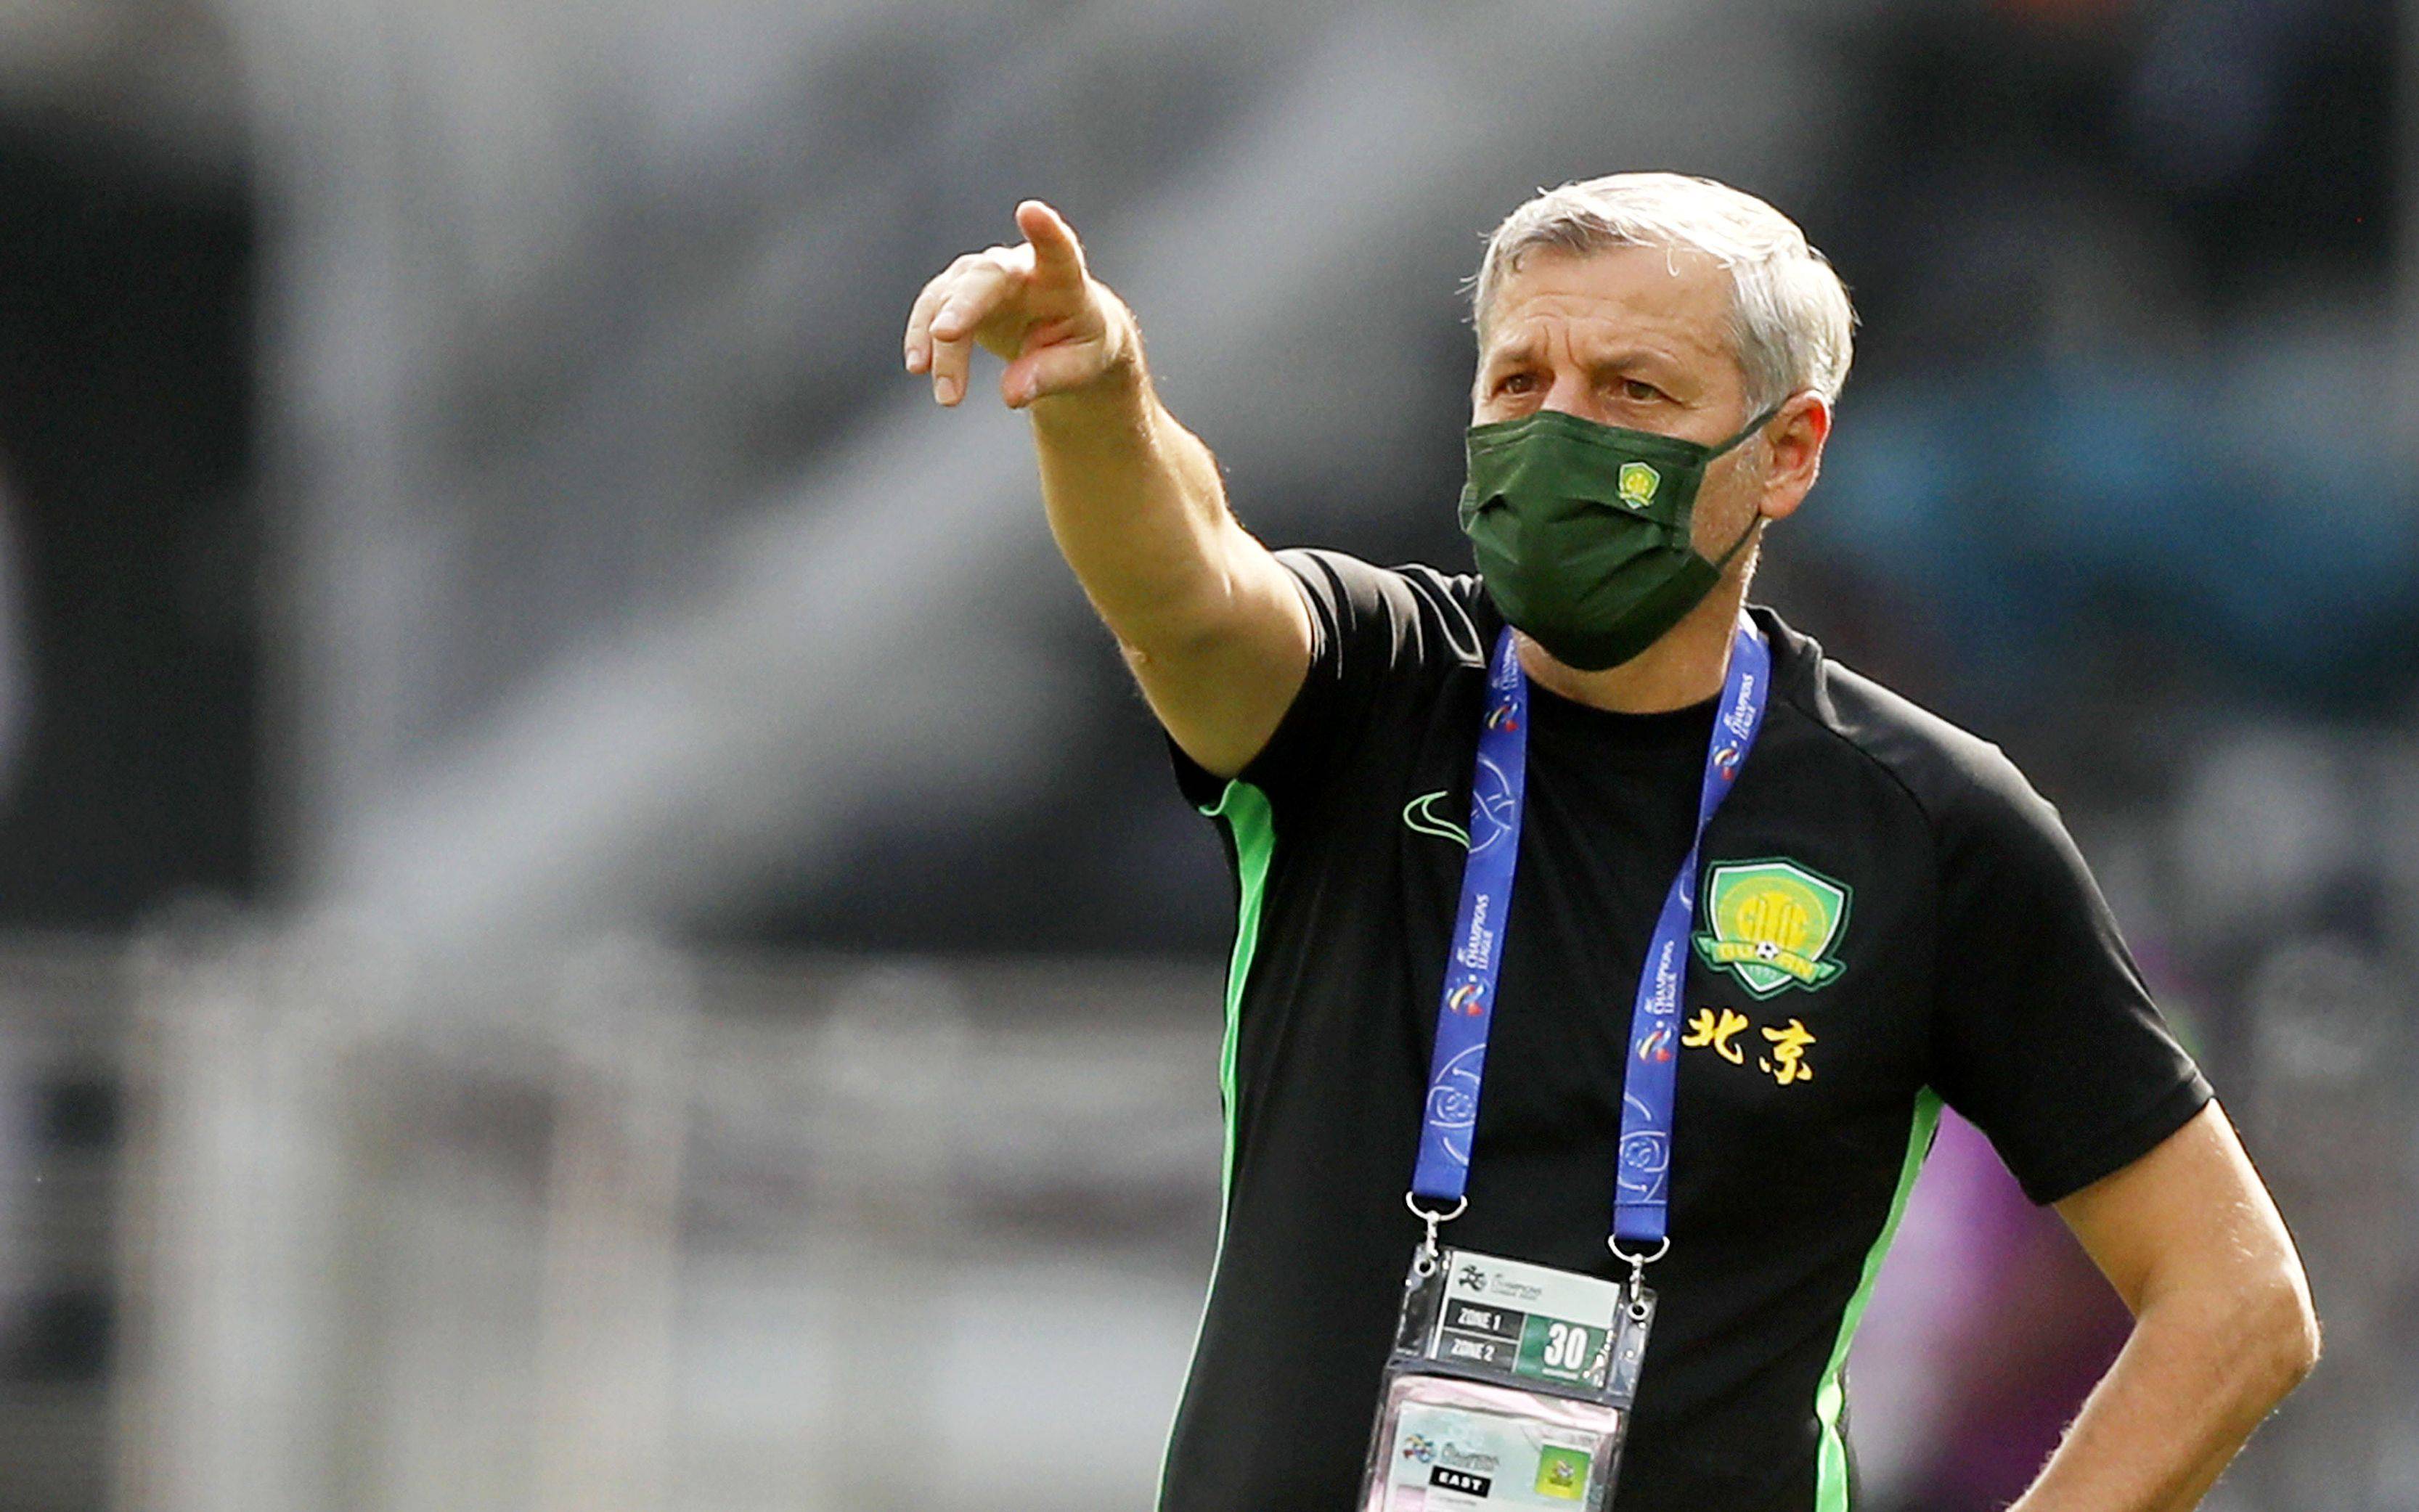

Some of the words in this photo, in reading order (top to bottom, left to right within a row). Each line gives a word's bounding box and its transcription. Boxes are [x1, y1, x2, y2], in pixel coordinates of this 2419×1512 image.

[1465, 893, 1490, 969] CHAMPIONS
[1681, 1007, 1816, 1085] 北京
[1457, 1307, 1491, 1330] ZONE
[1492, 1314, 1502, 1331] 1
[1451, 1338, 1485, 1360] ZONE
[1484, 1344, 1496, 1362] 2
[1543, 1322, 1588, 1370] 30
[1438, 1471, 1483, 1492] EAST
